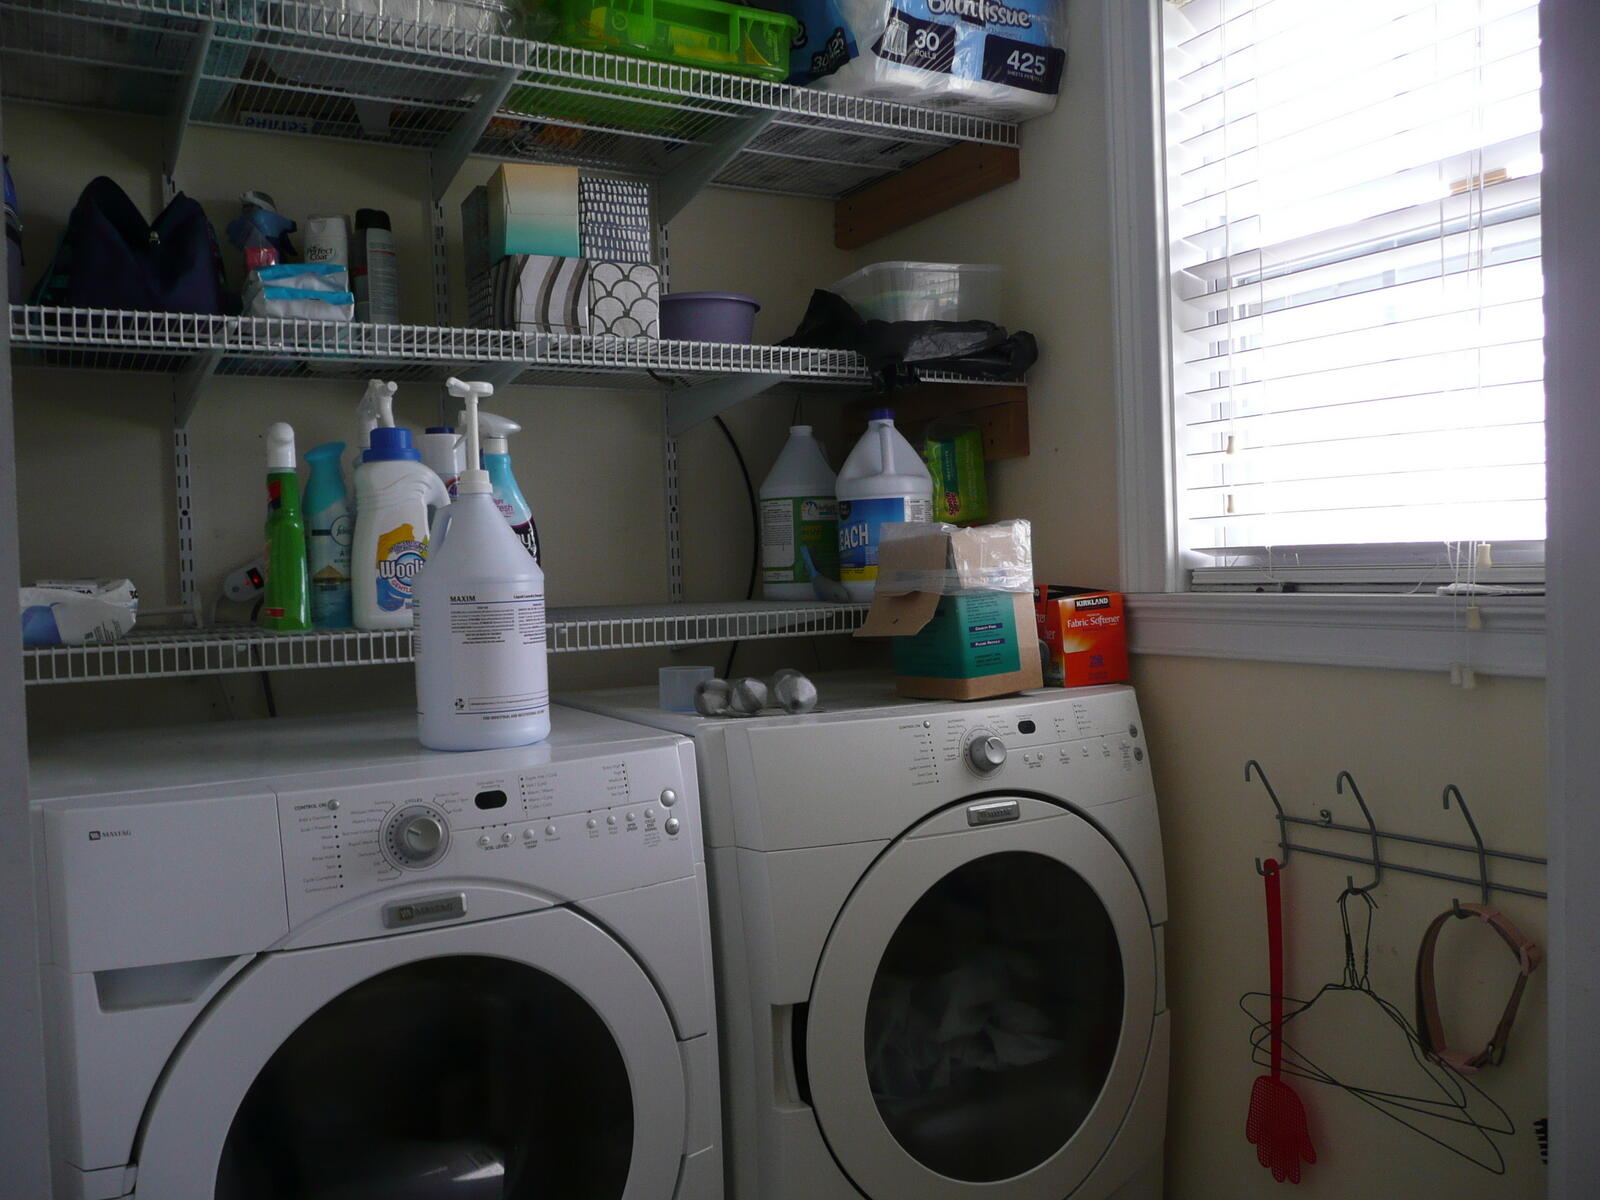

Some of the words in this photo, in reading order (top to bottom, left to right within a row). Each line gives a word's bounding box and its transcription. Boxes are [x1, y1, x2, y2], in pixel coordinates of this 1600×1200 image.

[914, 28, 940, 51] 30
[1006, 50, 1046, 76] 425
[839, 523, 869, 552] EACH
[379, 558, 425, 579] Wooli
[1076, 597, 1109, 608] KIRKLAND
[1067, 618, 1089, 628] Fabric
[1089, 615, 1120, 627] Softener
